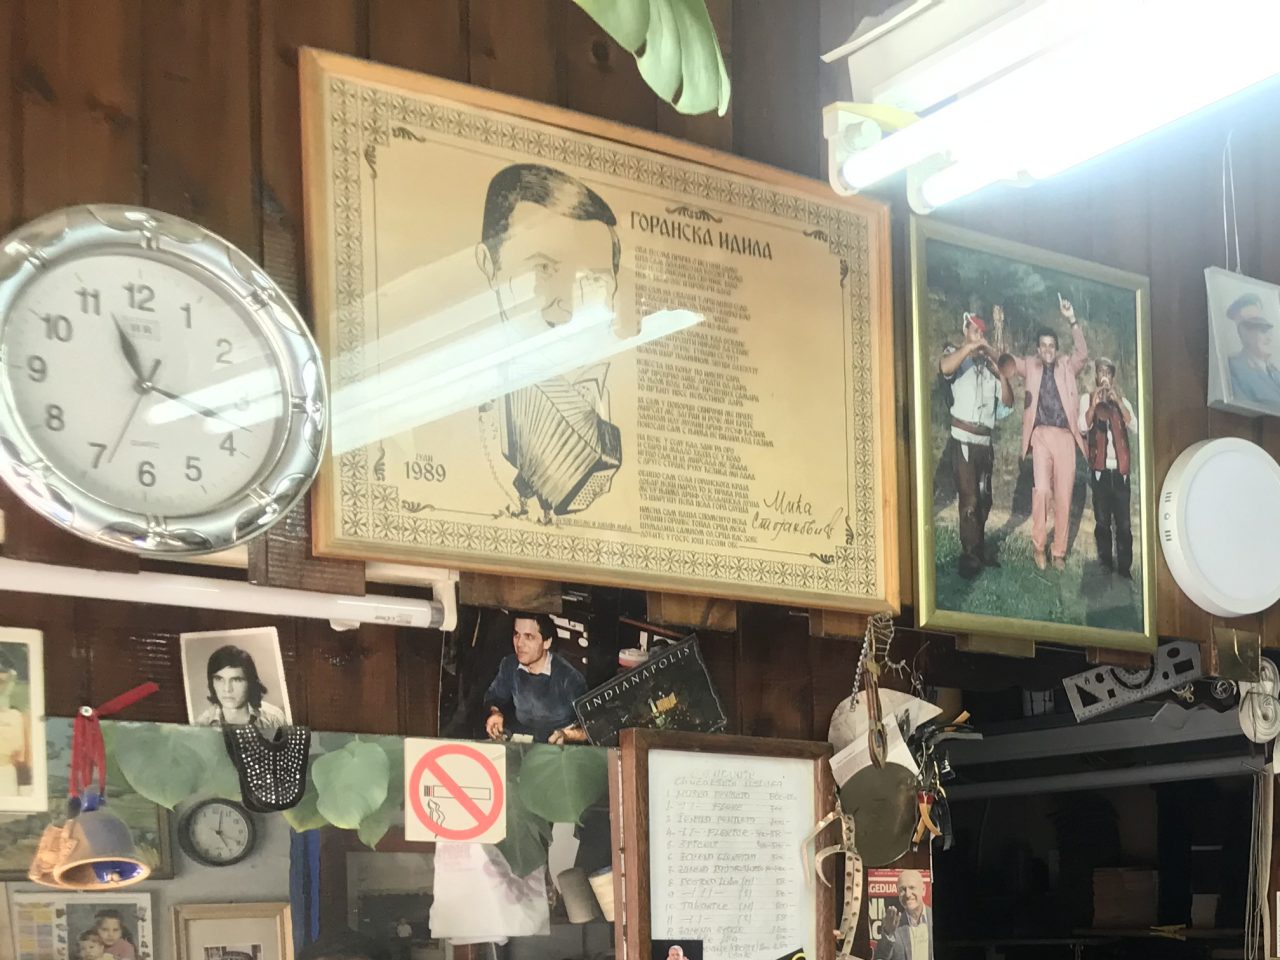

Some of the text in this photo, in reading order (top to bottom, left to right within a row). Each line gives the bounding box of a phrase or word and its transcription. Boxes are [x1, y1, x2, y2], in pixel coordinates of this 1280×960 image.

[630, 211, 713, 246] ГОРАНСКА
[76, 289, 101, 315] 11
[124, 284, 155, 312] 12
[42, 315, 72, 342] 10
[181, 303, 193, 329] 1
[217, 338, 233, 364] 2
[27, 356, 47, 383] 9
[46, 405, 65, 432] 8
[89, 443, 108, 469] 7
[220, 434, 236, 457] 4
[139, 461, 156, 488] 6
[186, 457, 203, 482] 5
[403, 461, 446, 482] 1989
[586, 647, 690, 711] INDIANAPOLIS
